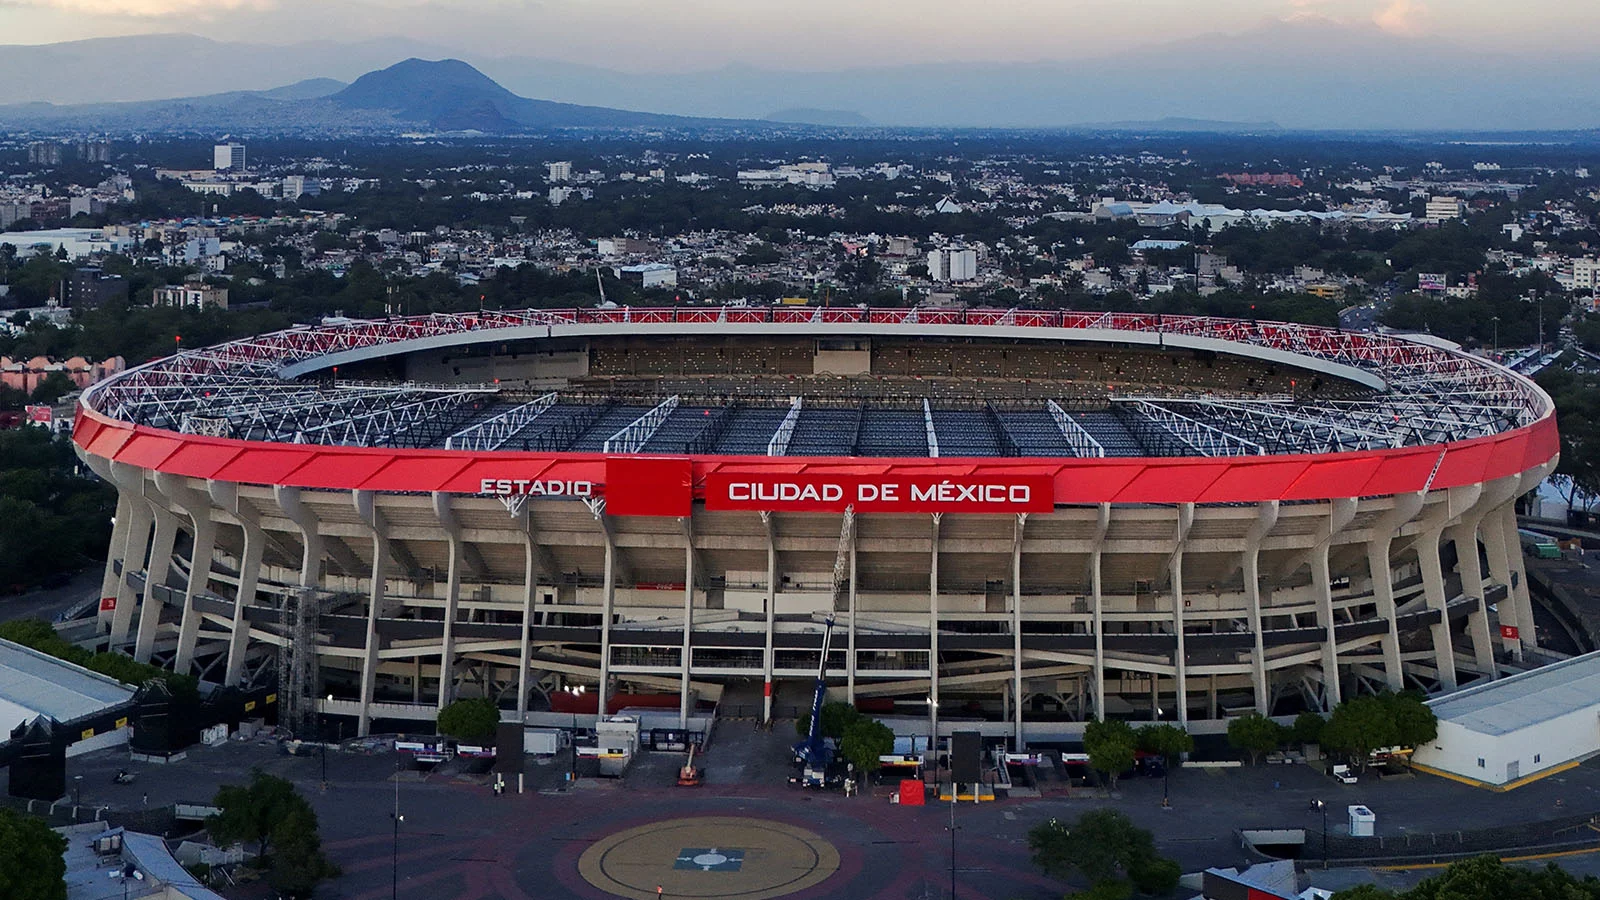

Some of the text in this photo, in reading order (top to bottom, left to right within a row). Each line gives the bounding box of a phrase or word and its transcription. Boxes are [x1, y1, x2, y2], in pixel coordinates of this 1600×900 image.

[480, 479, 592, 495] ESTADIO
[728, 480, 1031, 503] CIUDAD DE MÉXICO
